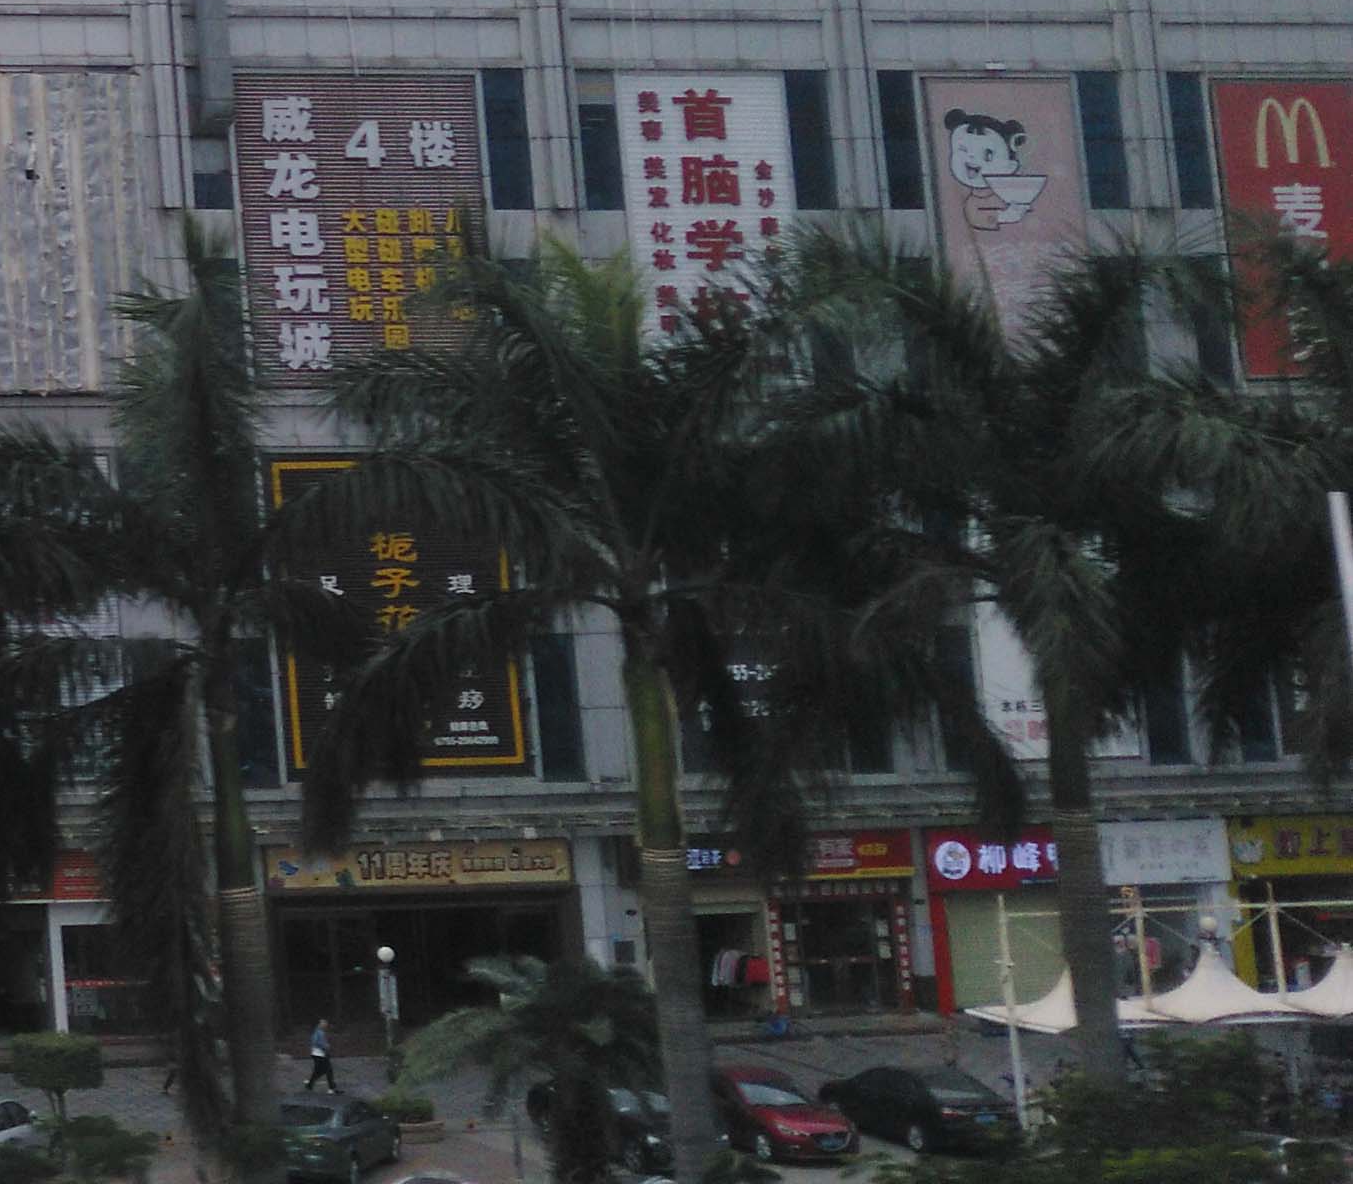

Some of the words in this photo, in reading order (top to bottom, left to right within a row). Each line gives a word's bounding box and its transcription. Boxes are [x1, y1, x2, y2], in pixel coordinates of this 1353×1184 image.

[344, 119, 457, 169] 4楼
[262, 95, 334, 370] 威龙电玩城
[341, 209, 374, 321] 大型电玩
